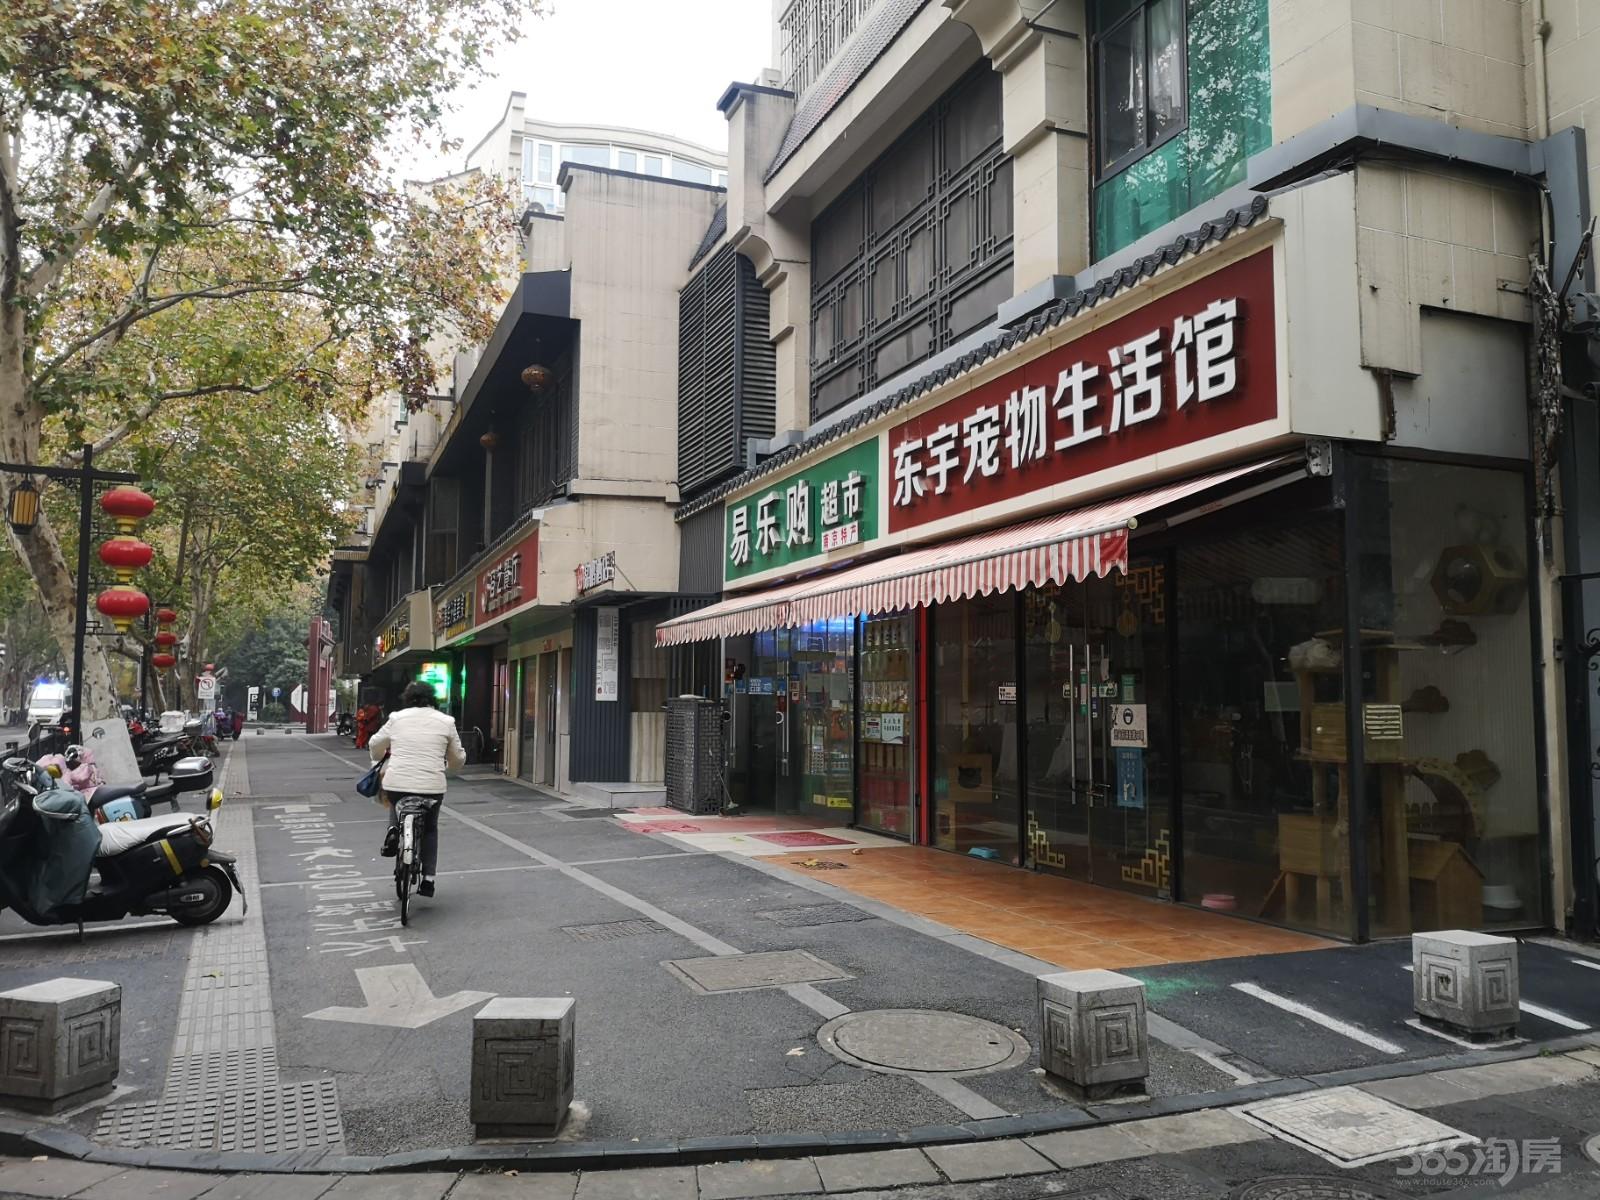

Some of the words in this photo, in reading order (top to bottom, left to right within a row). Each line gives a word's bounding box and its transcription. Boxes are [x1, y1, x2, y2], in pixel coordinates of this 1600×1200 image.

[892, 296, 1241, 507] 东宇宠物生活馆
[729, 479, 812, 567] 易乐购
[820, 470, 862, 527] 超市
